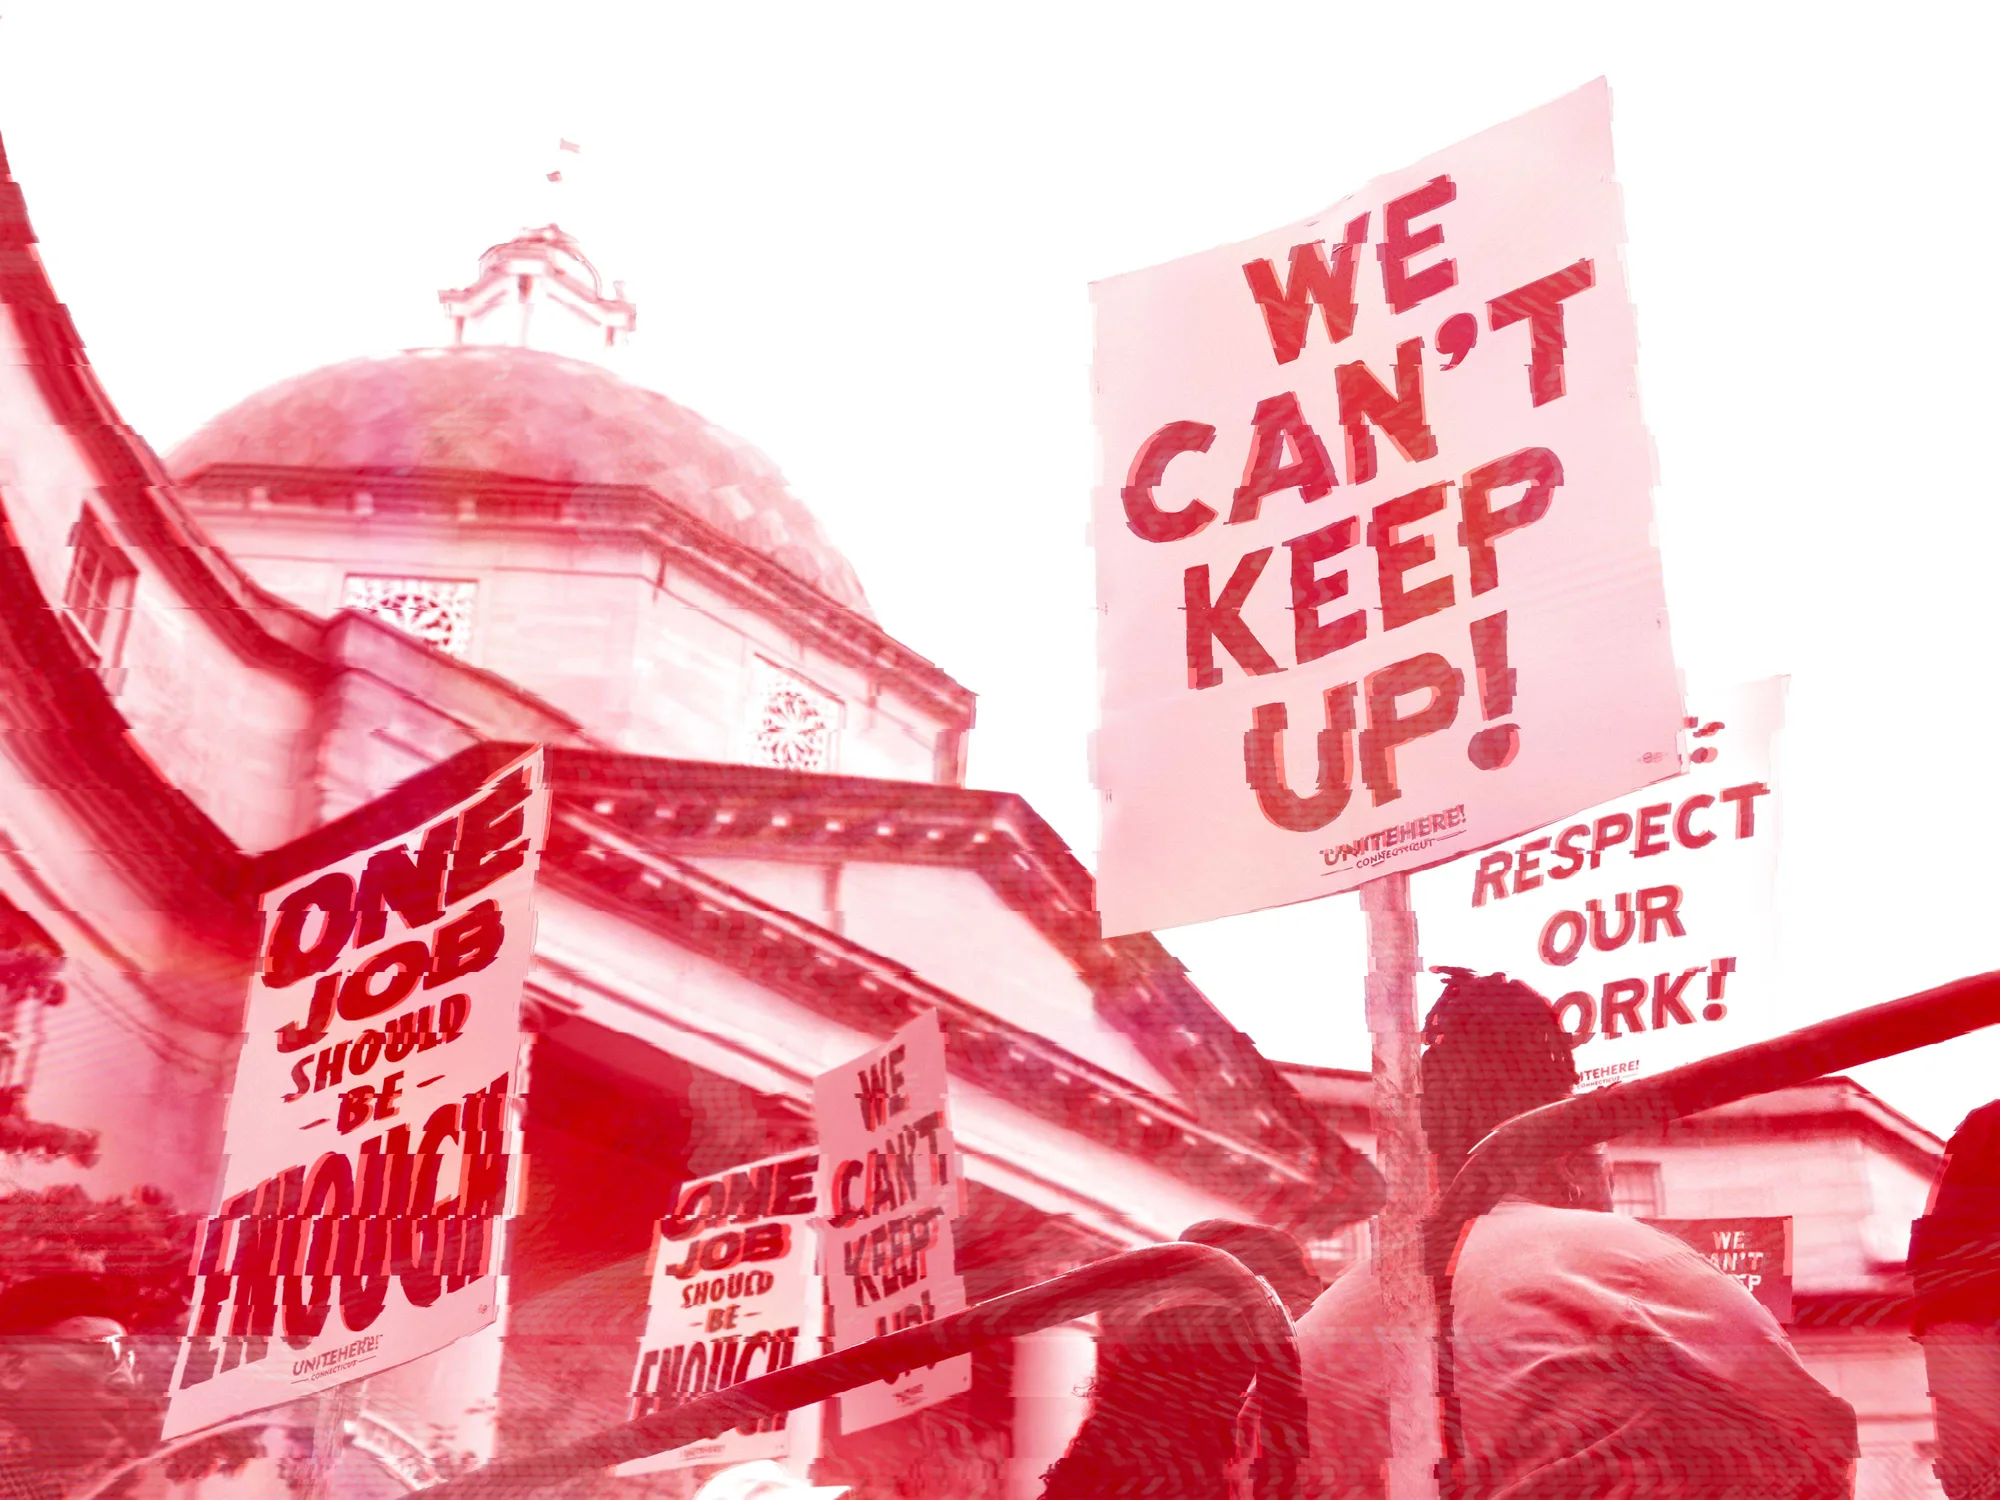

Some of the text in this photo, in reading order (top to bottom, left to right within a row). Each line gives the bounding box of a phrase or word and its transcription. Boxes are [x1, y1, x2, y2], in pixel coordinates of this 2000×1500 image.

[1242, 173, 1457, 365] WE
[1121, 258, 1596, 543] CAN'T
[1178, 446, 1565, 691] KEEP
[1244, 610, 1521, 832] UP!
[261, 765, 533, 989] ONE
[1356, 838, 1436, 869] CONNECTICUT
[1471, 782, 1770, 908] RESPECT
[1538, 884, 1687, 966] OUR
[276, 898, 506, 1054] JOB
[1555, 957, 1736, 1049] ORK!
[282, 993, 472, 1103] SHOULD
[854, 1043, 910, 1132] WE
[1576, 1075, 1622, 1090] CONNECTICUT
[1579, 1059, 1640, 1082] ITEHERE!
[337, 1070, 405, 1135] BE
[660, 1153, 819, 1242] ONE
[828, 1111, 949, 1229] CAN'T
[178, 1071, 510, 1390] ENOUGH
[665, 1222, 792, 1280] JOB
[844, 1206, 945, 1308] KEEP
[1706, 1251, 1764, 1271] AN'T
[1711, 1230, 1747, 1250] WE
[680, 1269, 774, 1309] SHOULD
[704, 1304, 741, 1333] BE
[310, 1359, 358, 1381] CONNECTICUT
